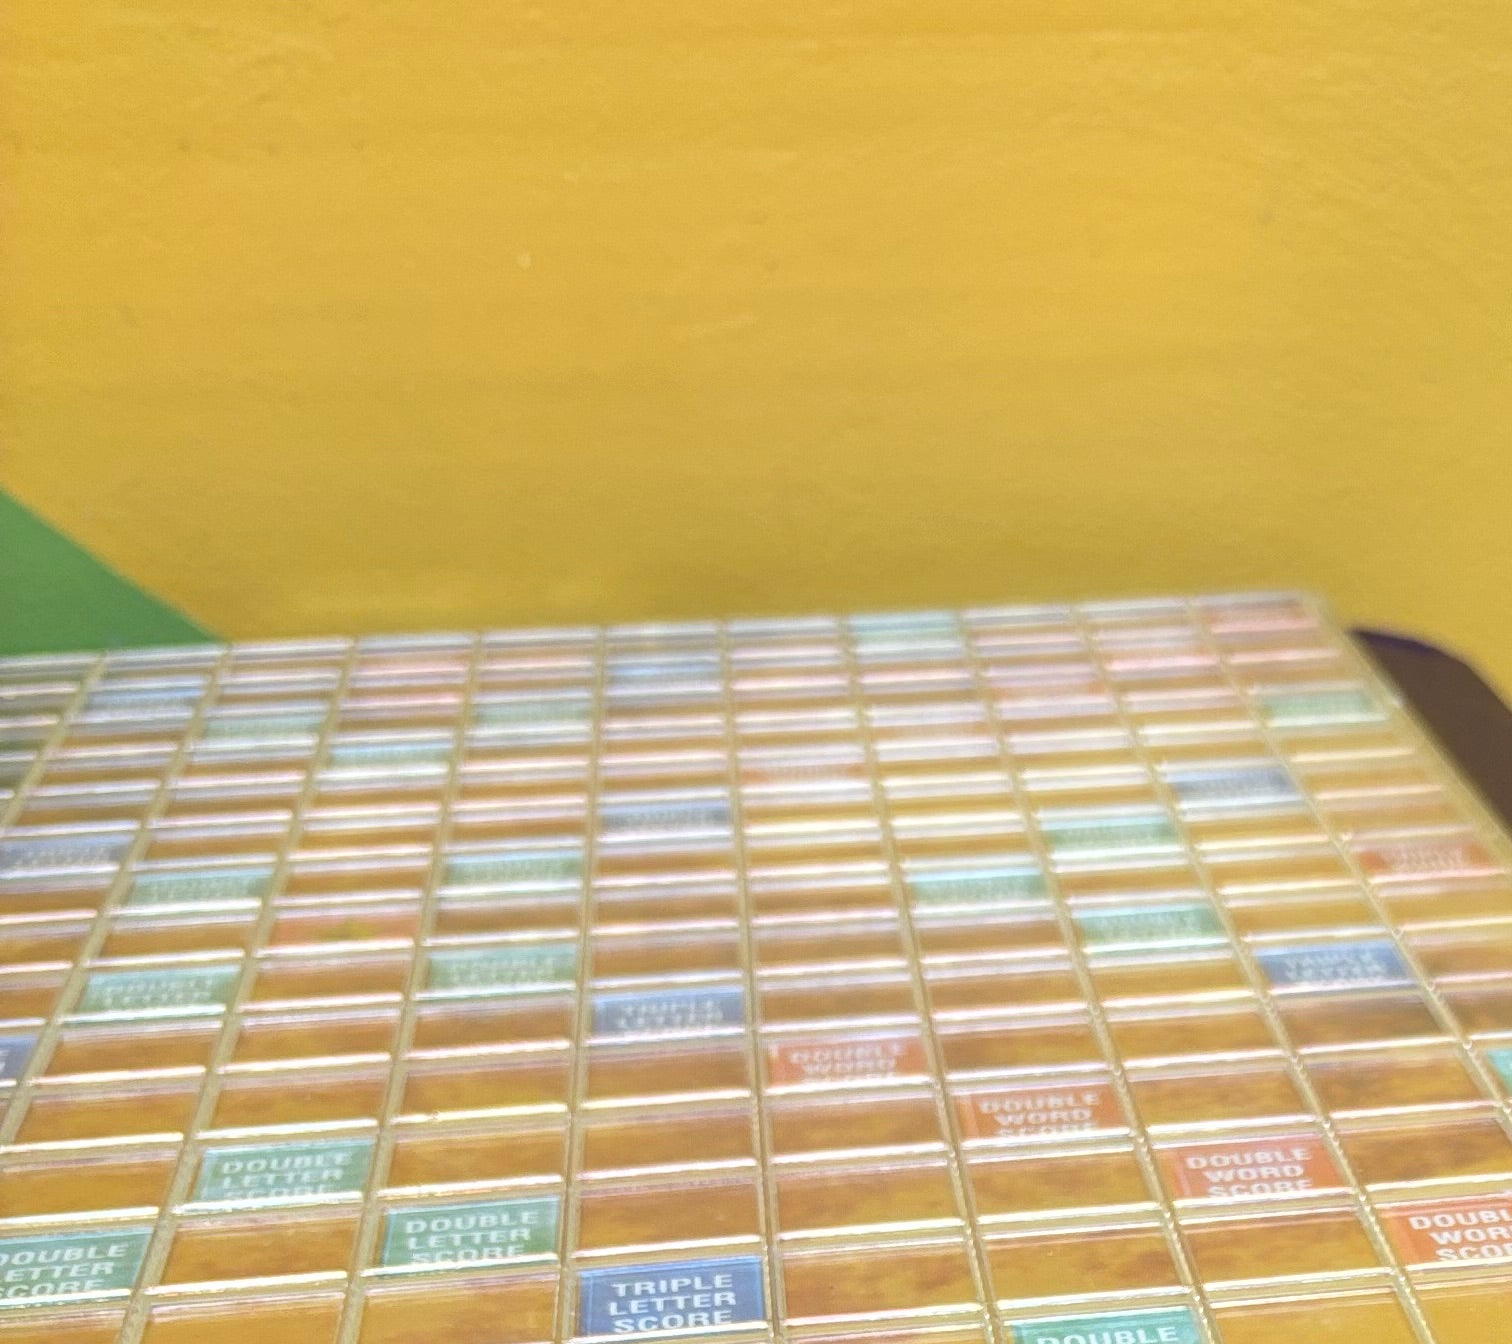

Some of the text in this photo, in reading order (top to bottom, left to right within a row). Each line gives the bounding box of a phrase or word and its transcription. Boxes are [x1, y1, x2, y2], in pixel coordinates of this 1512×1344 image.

[979, 1089, 1100, 1115] DOUBLE
[993, 1108, 1093, 1127] WORD
[222, 1152, 353, 1175] DOUBLE
[1185, 1147, 1313, 1170] DOUBLE
[222, 1168, 344, 1190] LETTER
[1203, 1164, 1304, 1184] WORD
[405, 1210, 540, 1235] DOUBLE
[407, 1227, 531, 1251] LETTER
[0, 1261, 115, 1282] ETTER
[612, 1274, 733, 1298] TRIPLE
[609, 1291, 737, 1317] LETTER
[612, 1309, 734, 1335] SCORE
